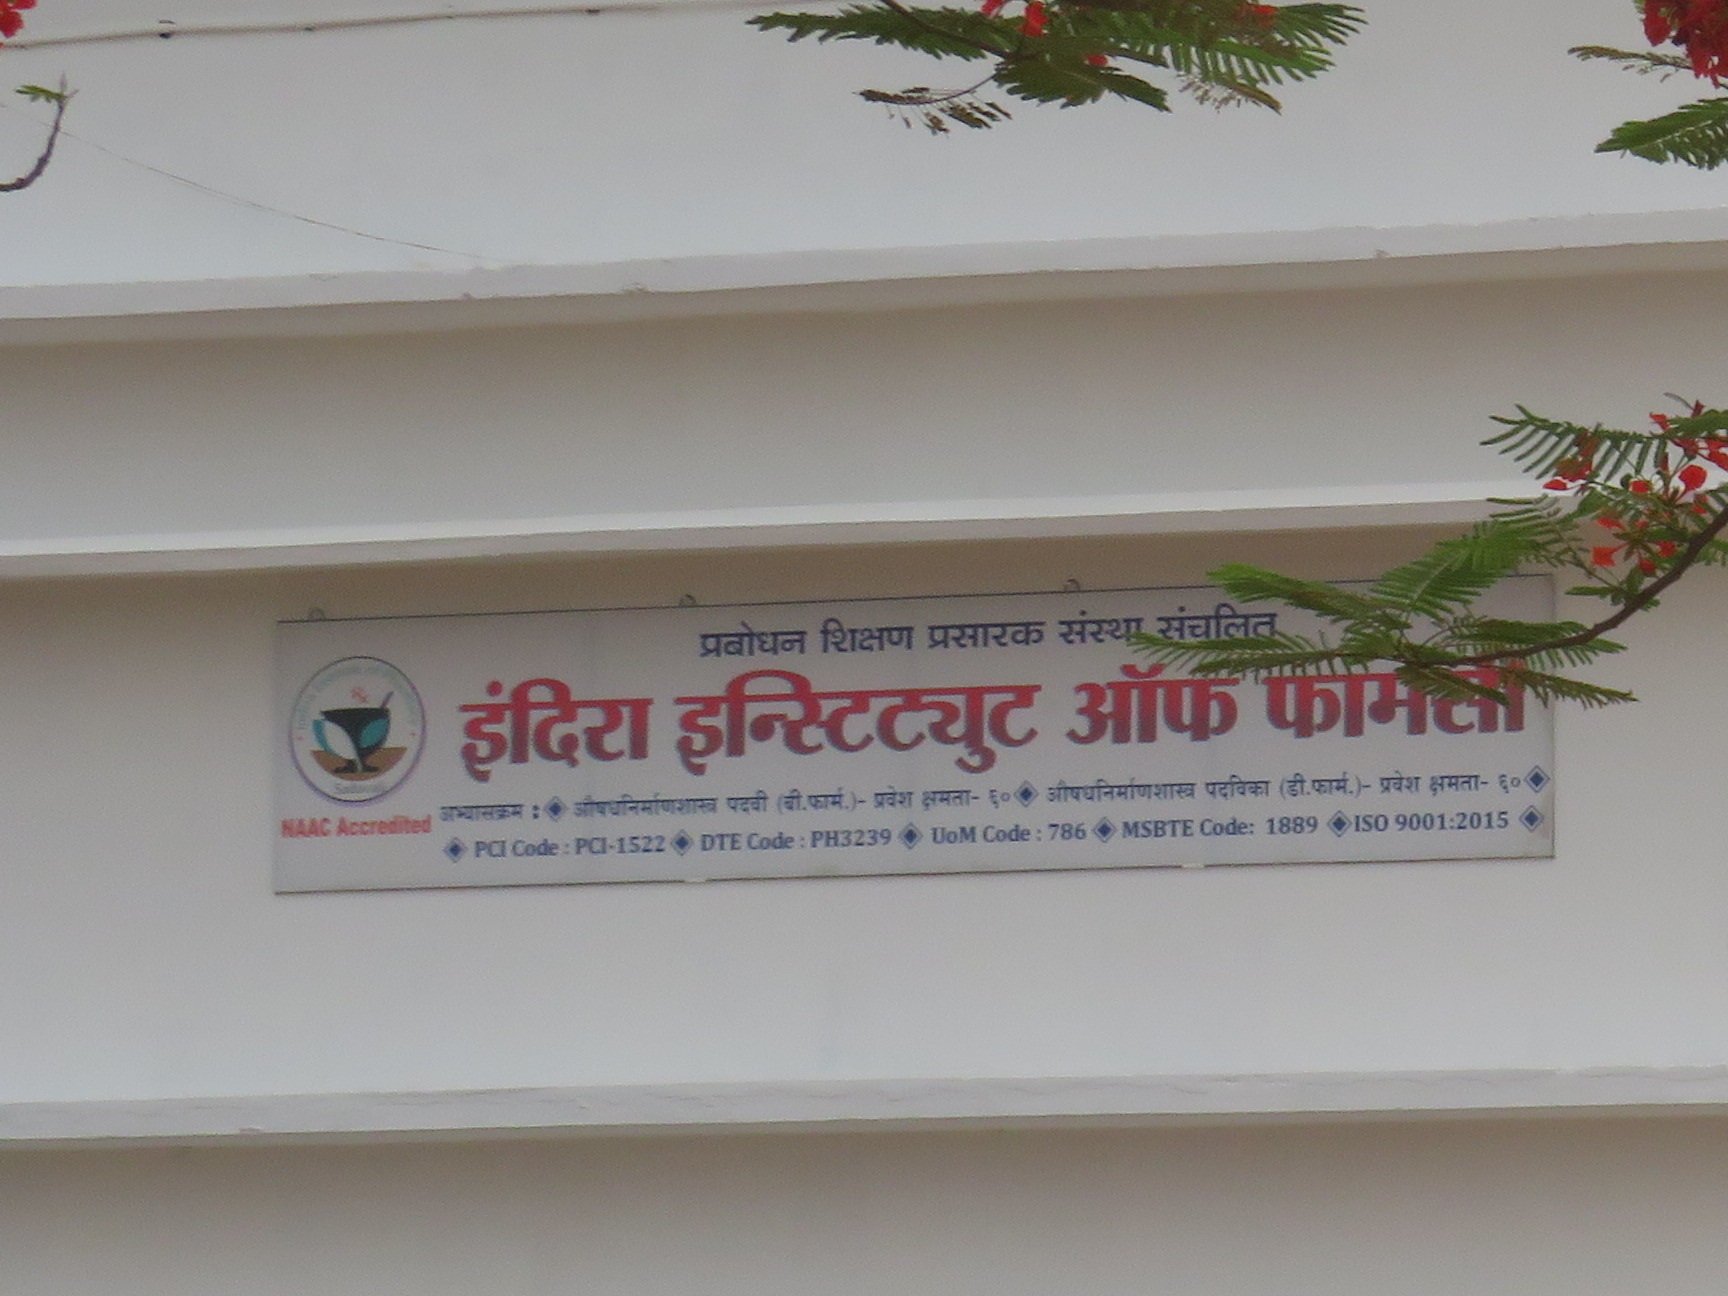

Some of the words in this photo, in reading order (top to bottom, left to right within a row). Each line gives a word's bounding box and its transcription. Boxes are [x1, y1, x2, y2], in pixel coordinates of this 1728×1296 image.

[699, 621, 807, 657] प्रबोधन
[820, 618, 914, 654] शिक्षण
[927, 621, 1047, 649] प्रसारक
[1058, 610, 1144, 644] संस्था
[1157, 603, 1278, 640] संचलित
[459, 678, 653, 783] इंदिरा
[674, 669, 1041, 775] इन्स्टिट्युट
[1066, 663, 1241, 745] ऑफ
[1205, 774, 1271, 799] पदविका
[1379, 770, 1421, 794] प्रवेश
[1429, 774, 1488, 797] क्षमता-
[1498, 774, 1521, 794] ६०
[726, 790, 769, 813] पदवी
[873, 785, 914, 809] प्रवेश
[922, 789, 980, 811] क्षमता-
[280, 818, 332, 838] NAAC
[335, 815, 433, 836] Accredited
[1122, 819, 1194, 838] MSBTE
[1199, 817, 1254, 836] Code:
[1267, 815, 1318, 835] 1889
[1354, 814, 1389, 833] ISO
[1394, 810, 1509, 830] 9001:2015
[700, 833, 742, 851] DTE
[746, 832, 795, 850] Code
[810, 828, 892, 849] PH3239
[931, 826, 976, 845] UoM
[982, 823, 1031, 843] Code
[1048, 823, 1087, 840] 786
[474, 840, 506, 858] PCI
[512, 838, 559, 857] Code
[575, 835, 666, 855] PCI-1522
